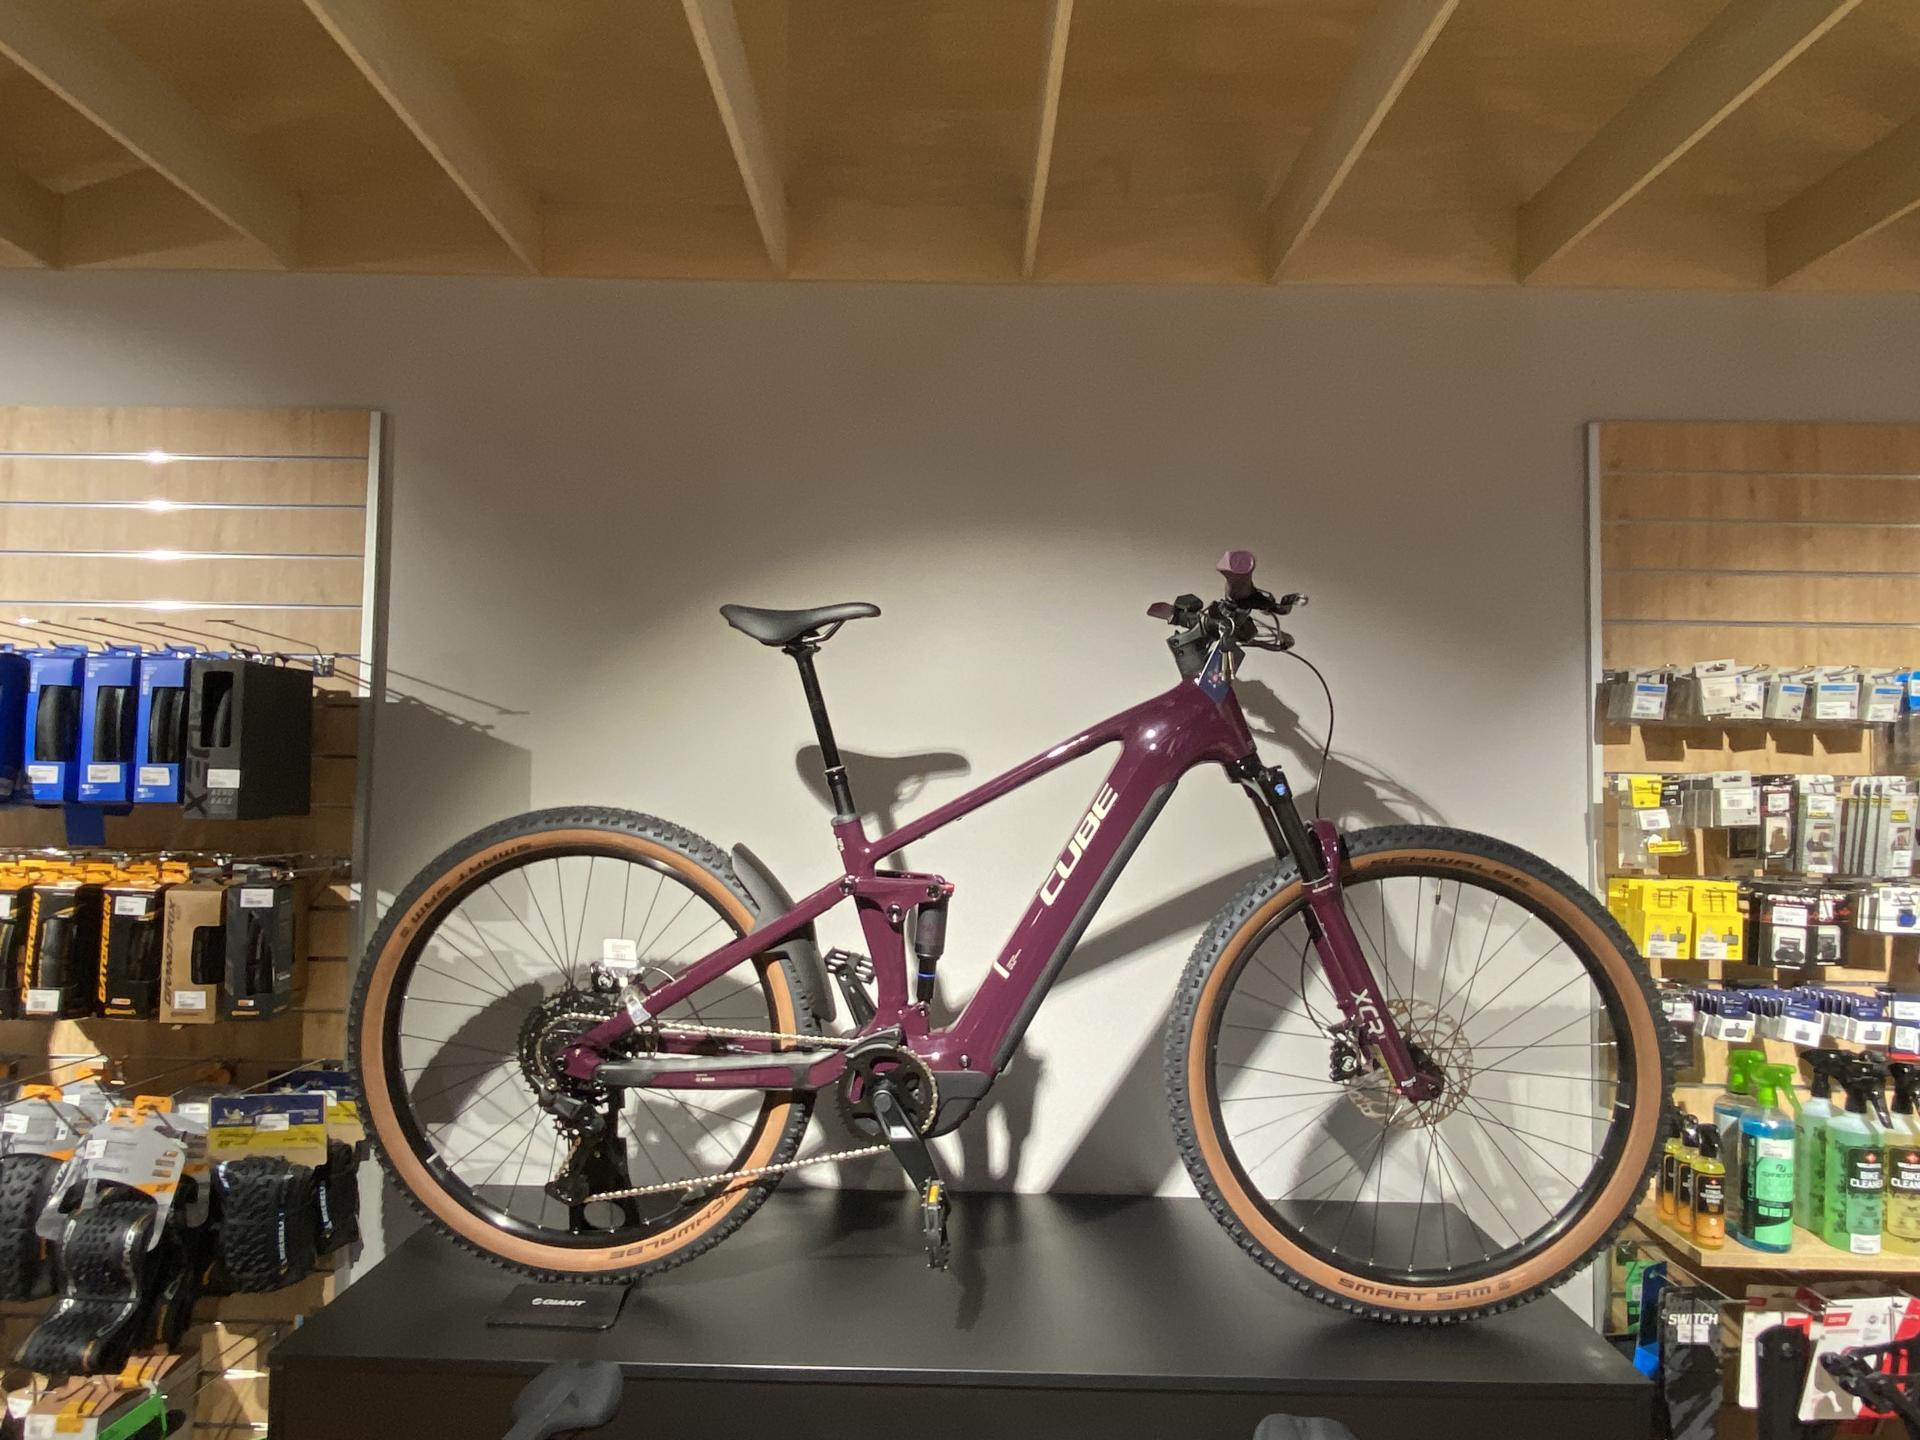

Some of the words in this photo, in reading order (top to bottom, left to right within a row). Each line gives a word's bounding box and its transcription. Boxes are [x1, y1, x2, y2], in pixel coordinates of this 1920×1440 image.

[1040, 782, 1119, 906] CUBE
[1370, 856, 1530, 889] SCHWALBE
[98, 893, 112, 1003] GATORSKIN
[1350, 989, 1385, 1035] XCR
[542, 1298, 587, 1307] GIANT
[1338, 1277, 1427, 1301] SMART
[1436, 1285, 1492, 1301] SAM
[1668, 1313, 1719, 1325] SWITCH
